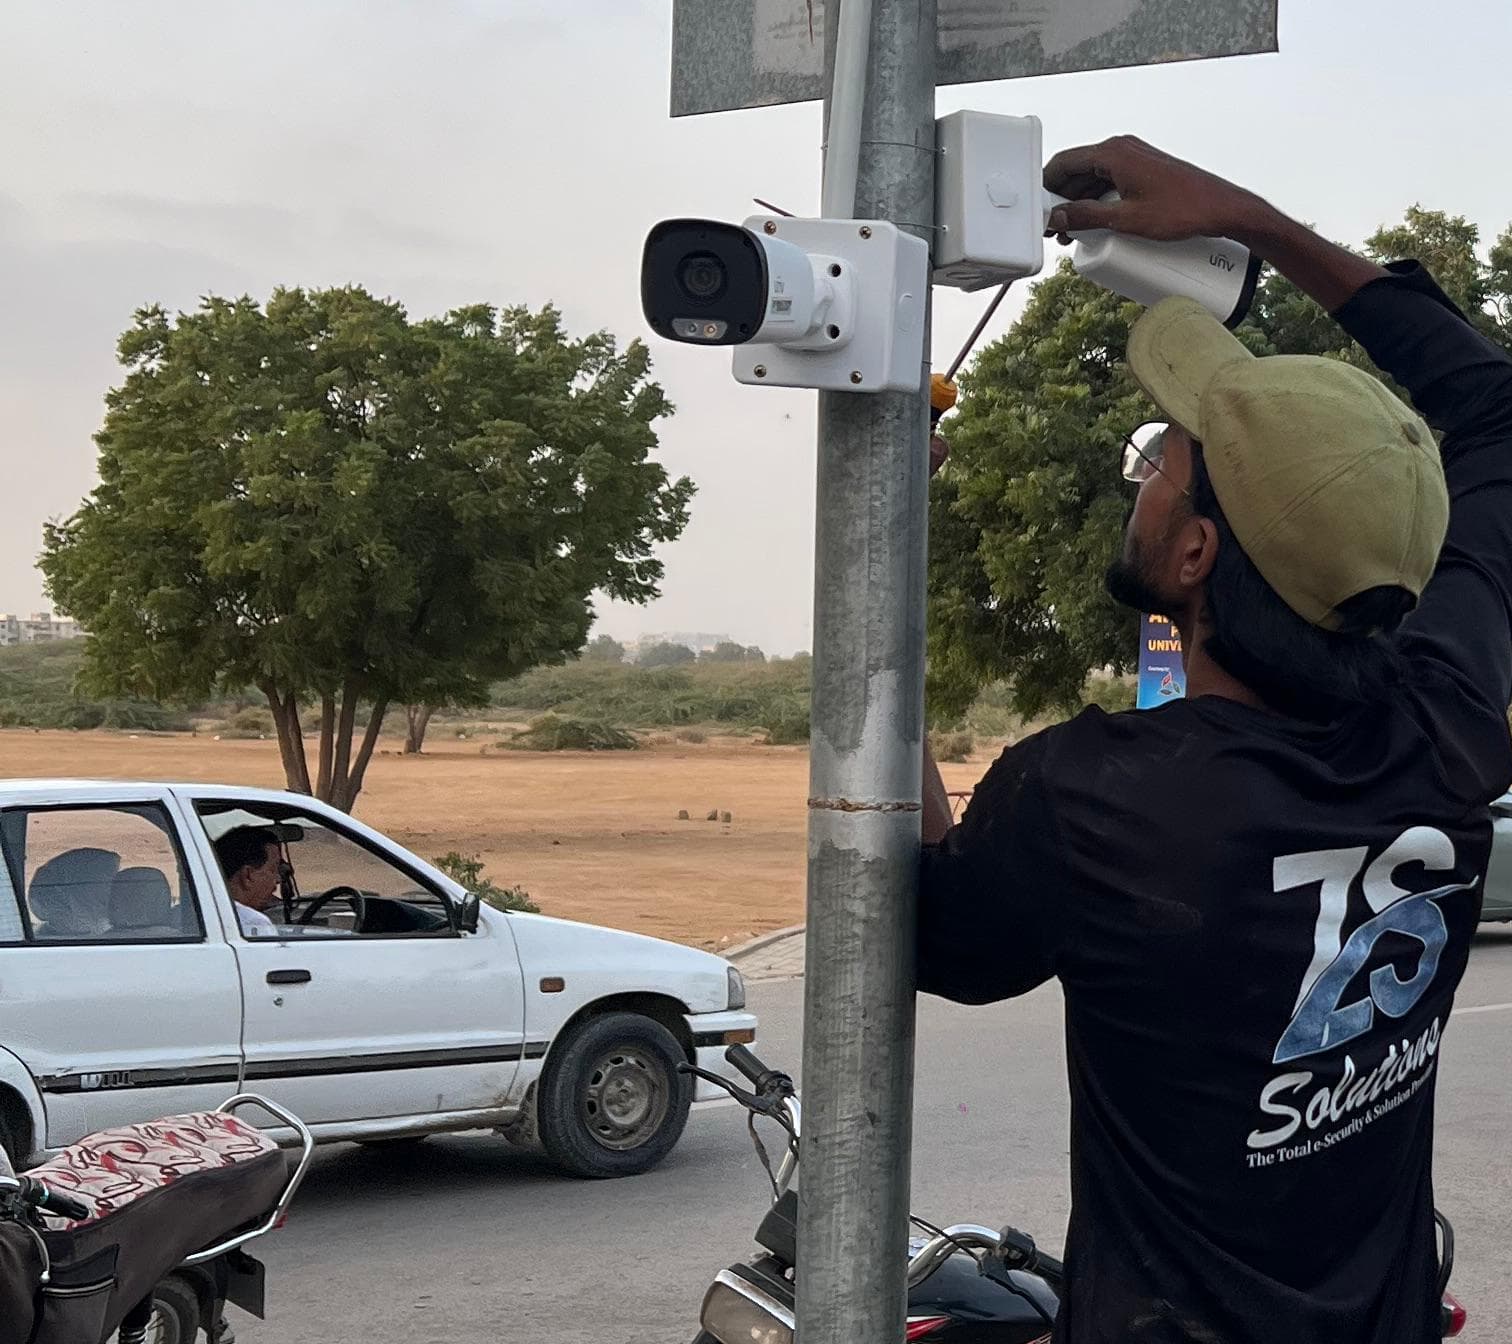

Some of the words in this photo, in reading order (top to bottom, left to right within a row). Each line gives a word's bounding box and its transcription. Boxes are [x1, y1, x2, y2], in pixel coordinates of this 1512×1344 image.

[1246, 1152, 1275, 1168] The
[1276, 1140, 1312, 1163] Total
[1313, 1116, 1365, 1150] e-Security
[1365, 1109, 1373, 1124] &
[1373, 1088, 1411, 1120] Solution
